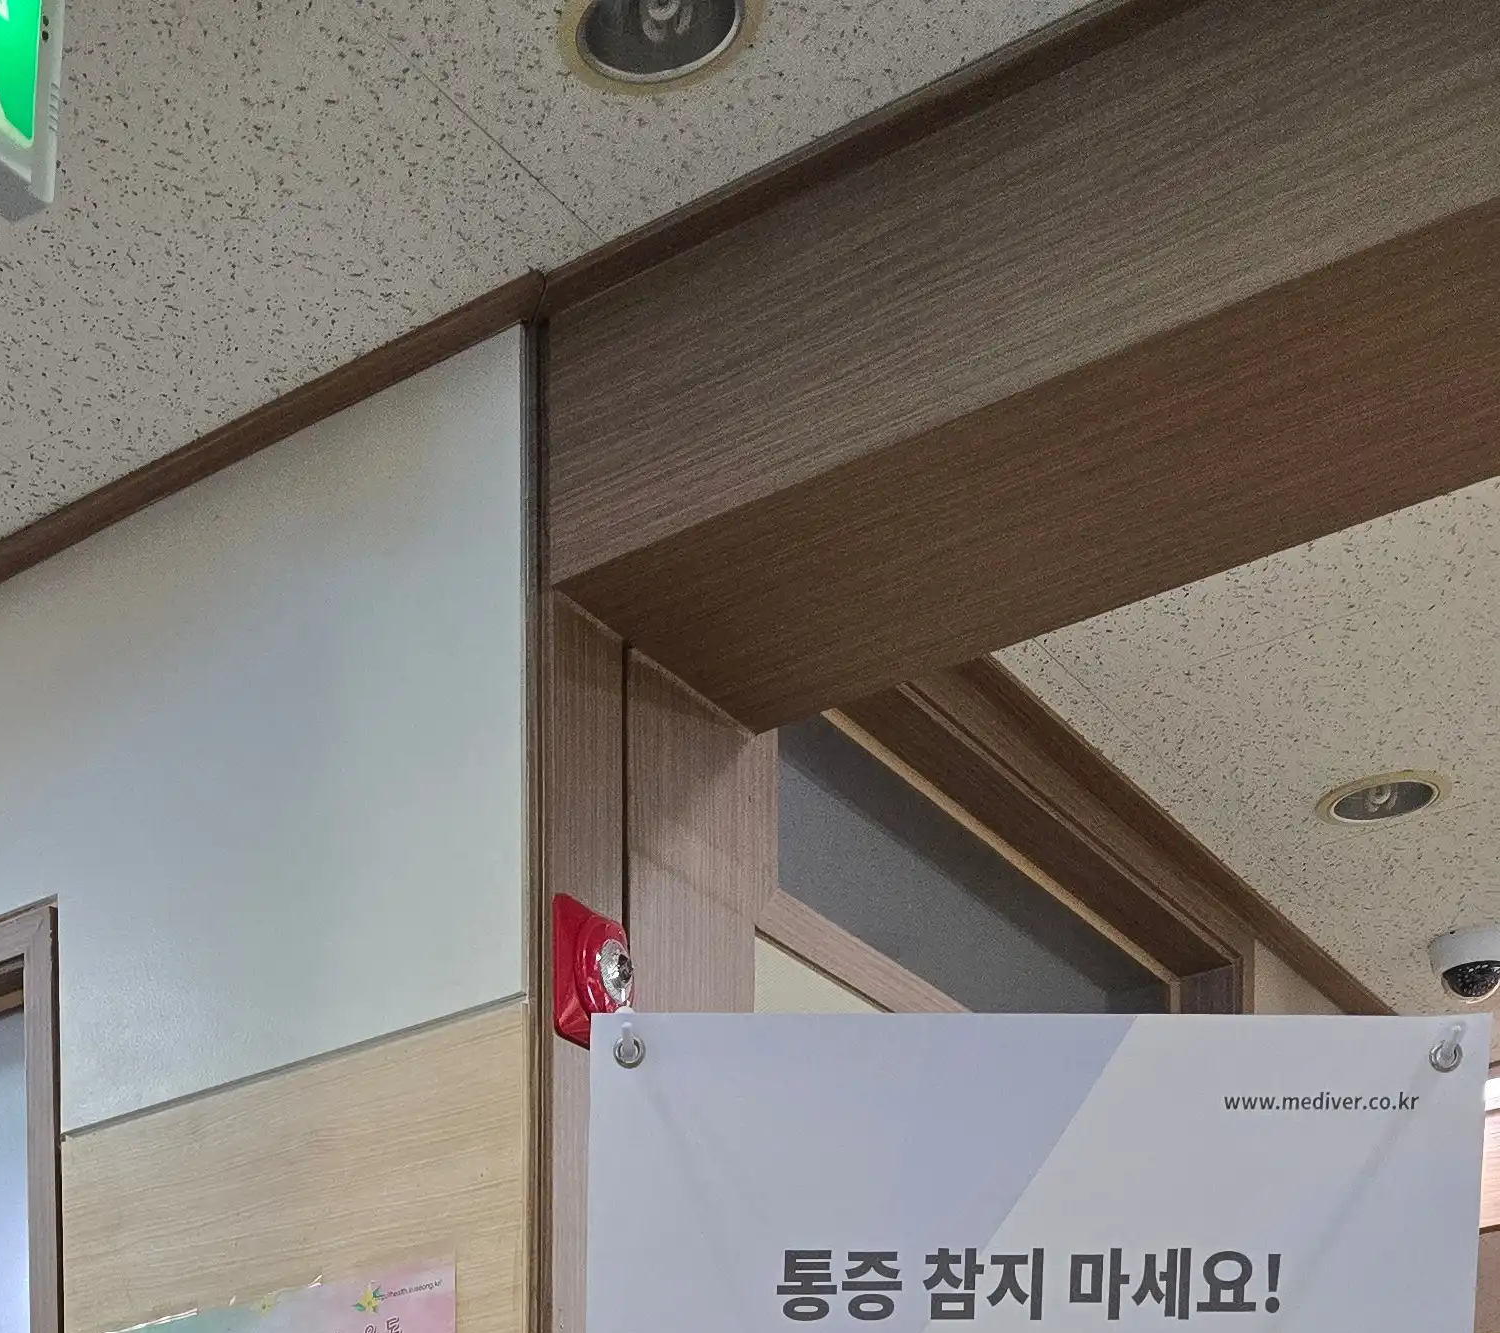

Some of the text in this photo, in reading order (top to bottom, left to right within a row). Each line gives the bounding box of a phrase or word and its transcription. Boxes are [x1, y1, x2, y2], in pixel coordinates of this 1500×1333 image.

[1225, 1092, 1419, 1110] www.mediver.co.kr
[777, 1248, 1281, 1321] 통증 참지 마세요!
